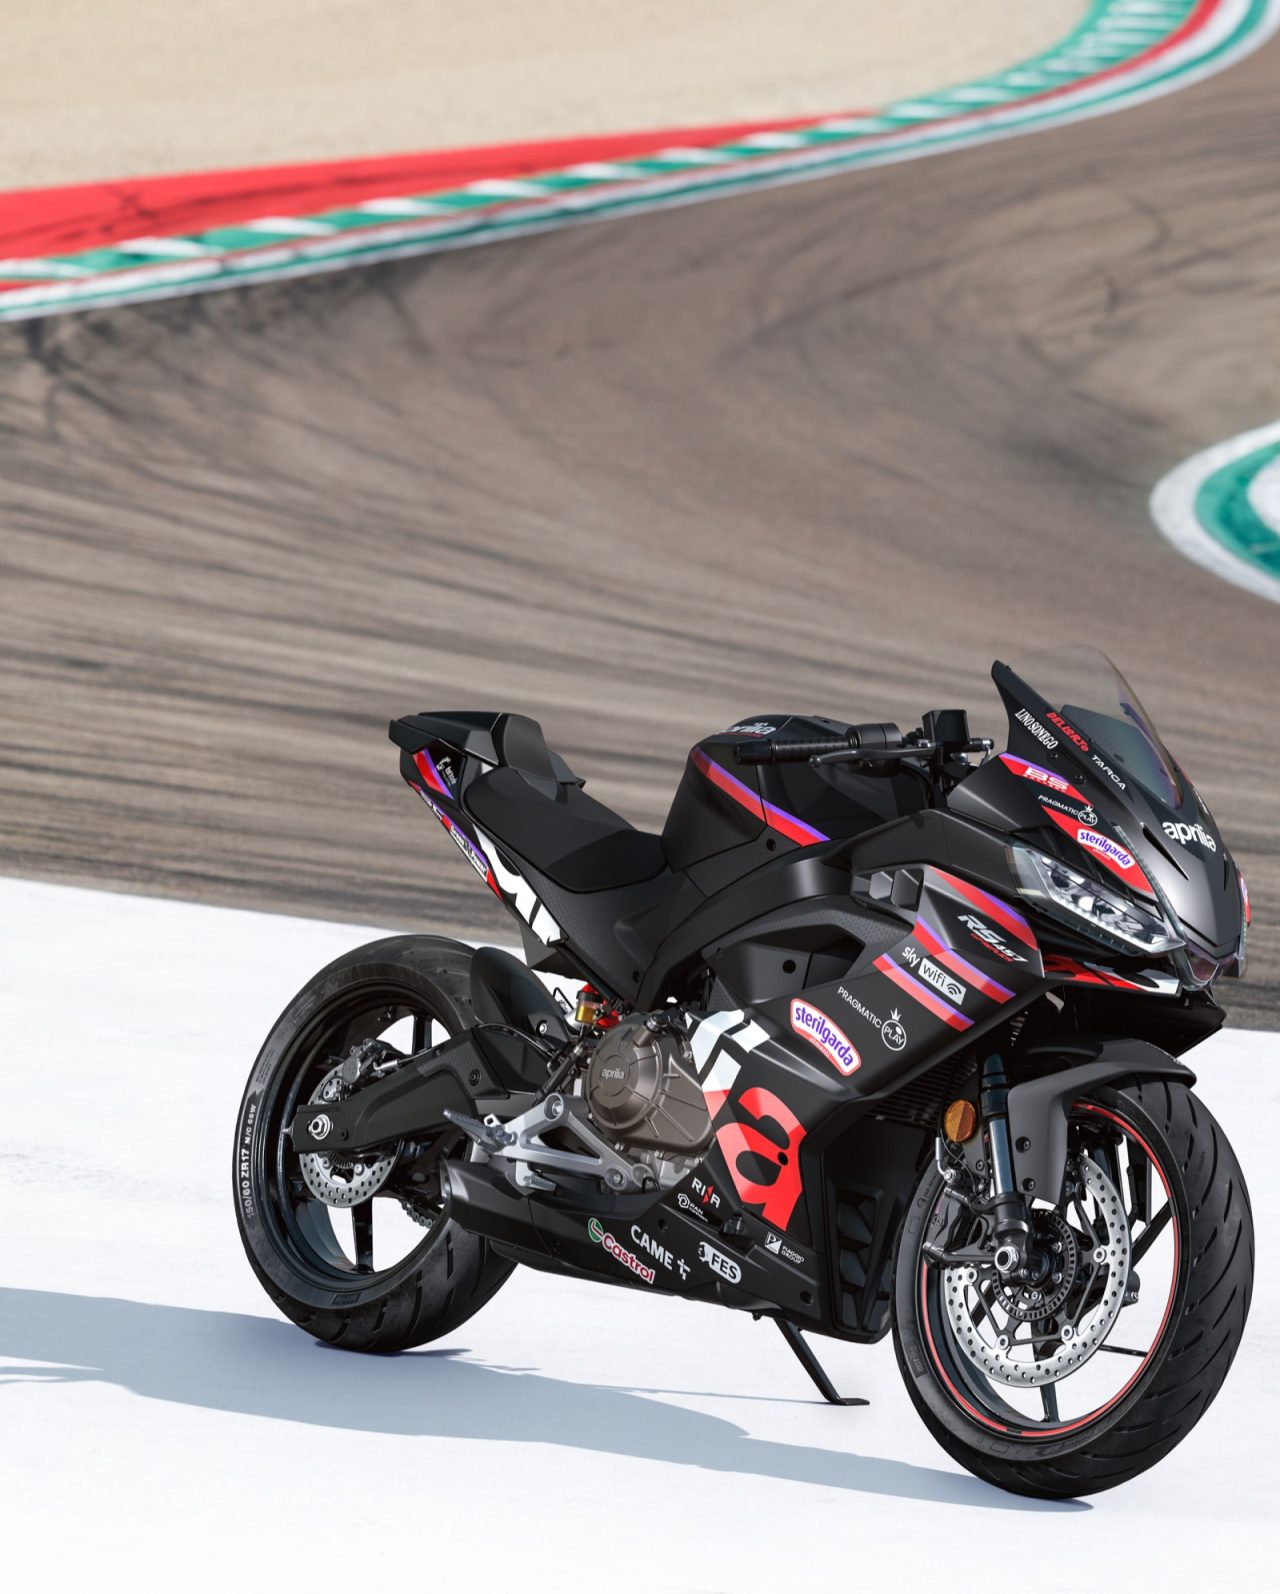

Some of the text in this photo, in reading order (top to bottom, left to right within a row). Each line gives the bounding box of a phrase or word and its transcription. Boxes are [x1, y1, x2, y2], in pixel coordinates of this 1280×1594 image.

[1023, 766, 1069, 791] BS
[1091, 754, 1126, 791] TARGA
[1038, 794, 1097, 825] PRAGMATIC PLAY
[1079, 829, 1131, 868] sterilgarda
[1162, 821, 1216, 852] aprilia
[902, 945, 947, 988] sky wifi
[837, 986, 905, 1045] PRAGMATIC PLAY
[795, 1005, 854, 1067] sterilgarda
[601, 1067, 625, 1080] aprilia
[240, 1149, 250, 1179] ZR17
[602, 1231, 656, 1284] Castrol
[631, 1225, 673, 1270] CAME
[781, 1249, 801, 1264] GROUP
[782, 1245, 804, 1262] PIAGGIO
[711, 1250, 738, 1280] FES
